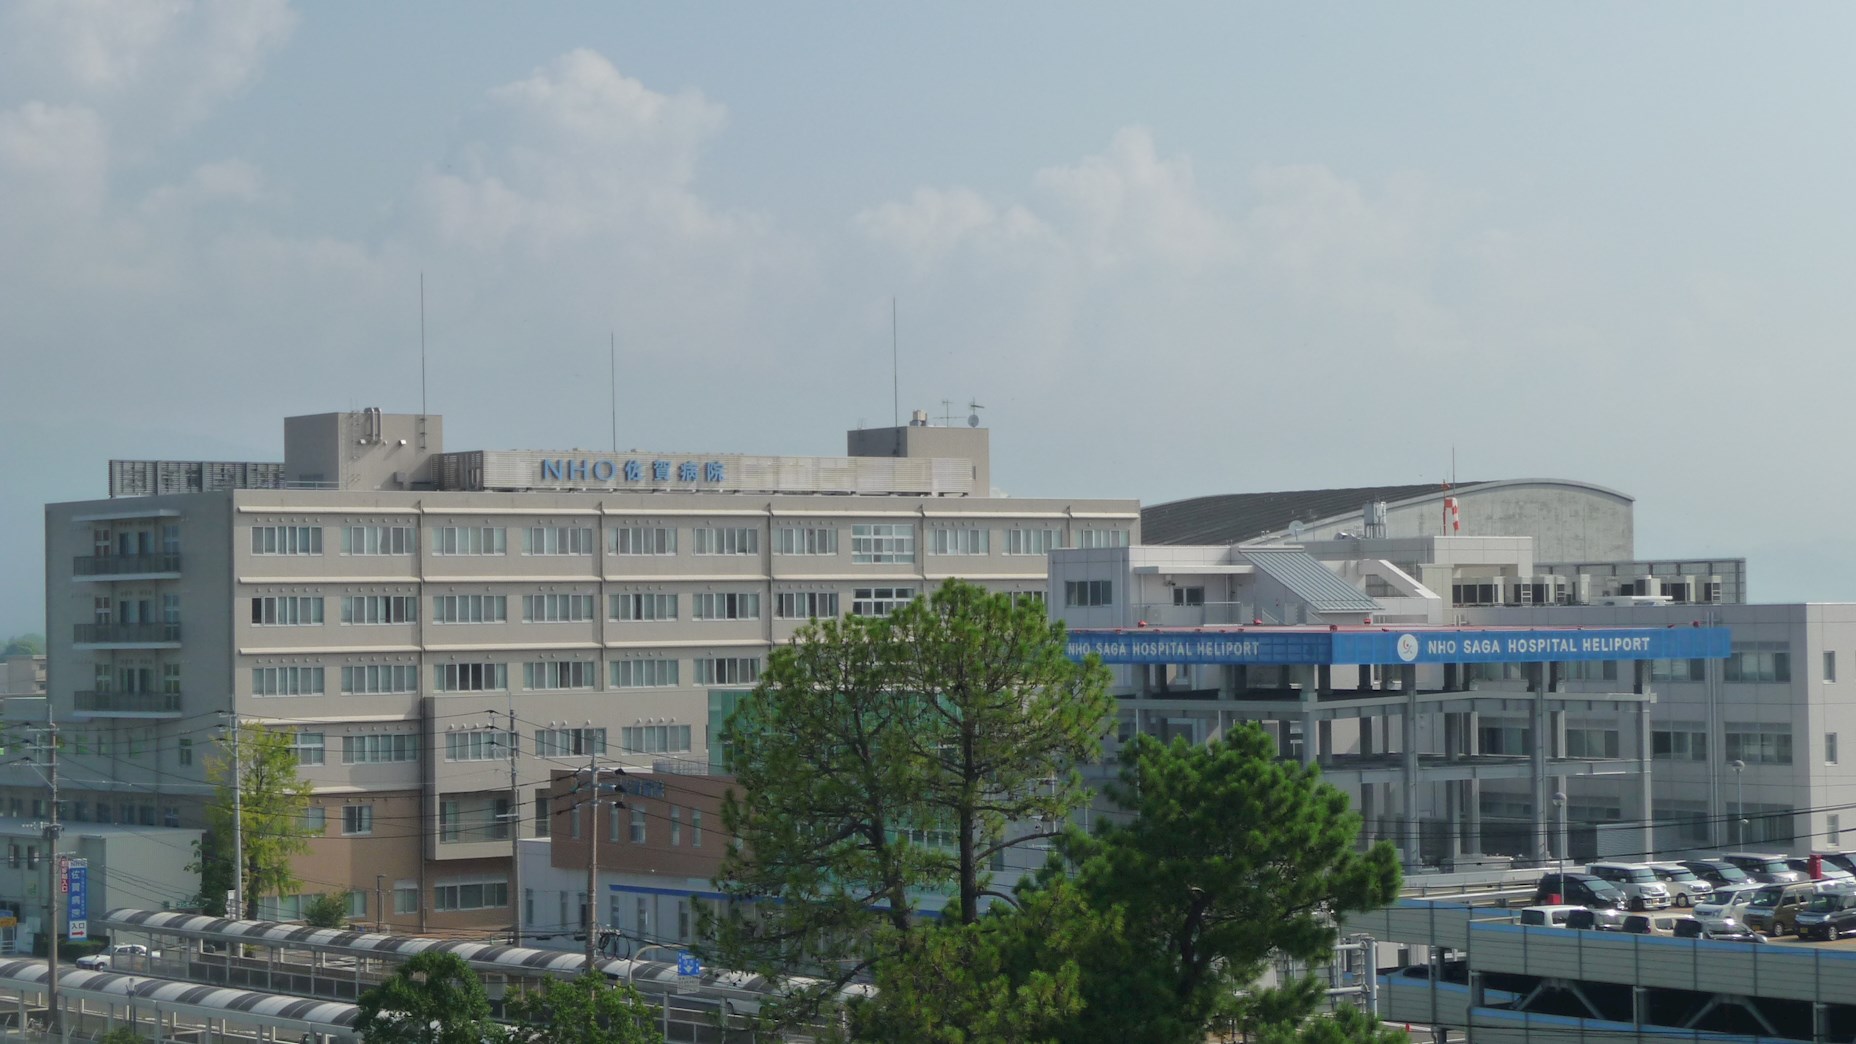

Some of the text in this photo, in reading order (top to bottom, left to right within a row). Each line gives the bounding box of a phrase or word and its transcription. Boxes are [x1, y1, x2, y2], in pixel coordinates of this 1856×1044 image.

[1068, 641, 1259, 656] NHO SAGA HOSPITAL HELIPORT
[1428, 637, 1650, 655] NHO SAGA HOSPITAL HELIPORT
